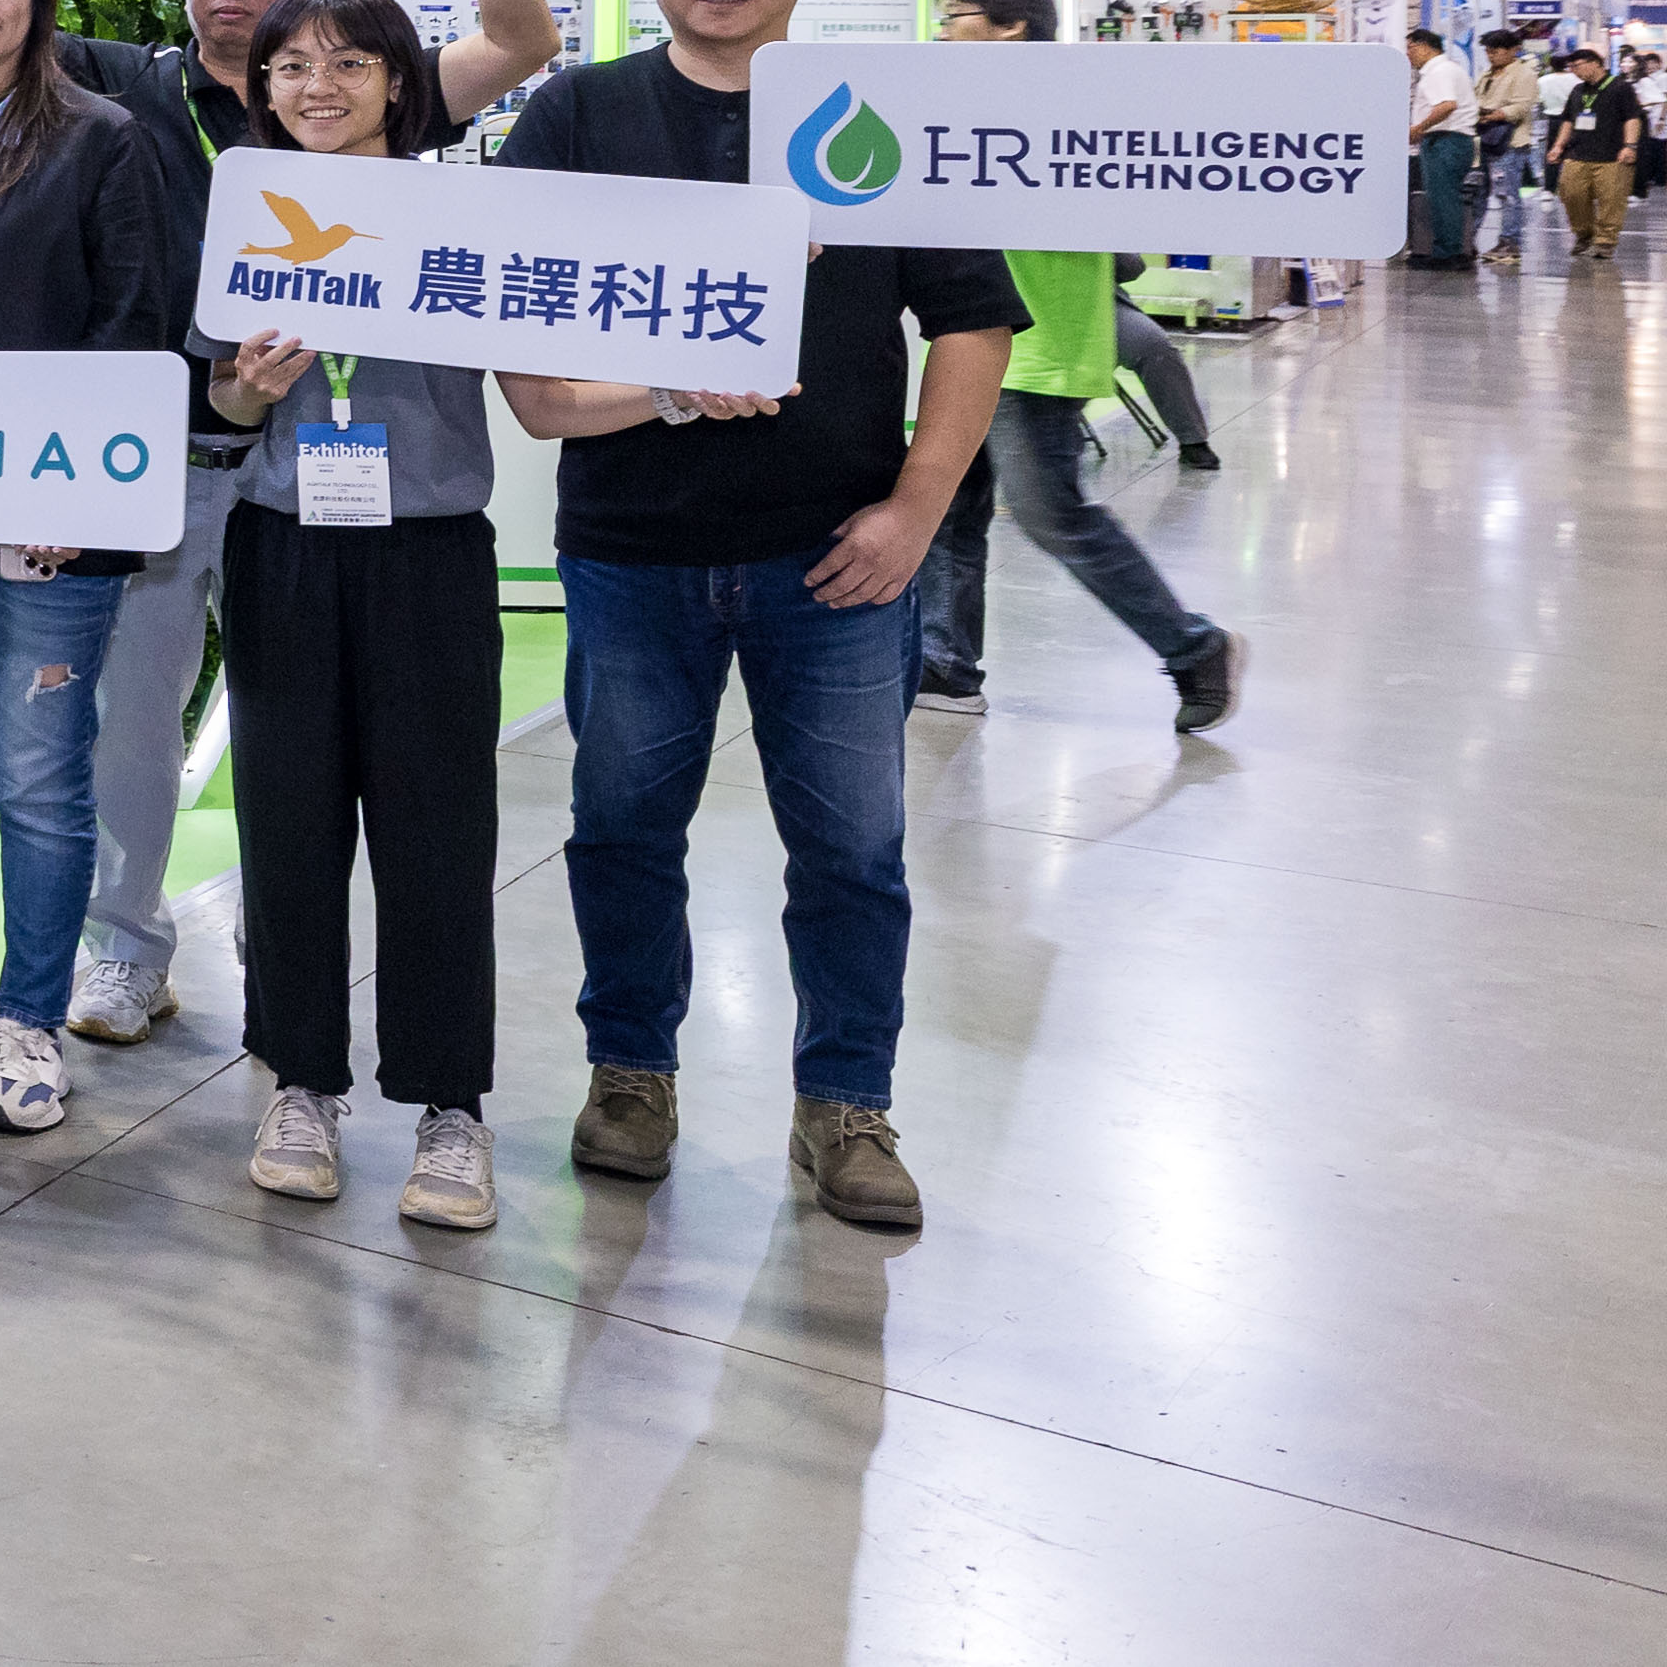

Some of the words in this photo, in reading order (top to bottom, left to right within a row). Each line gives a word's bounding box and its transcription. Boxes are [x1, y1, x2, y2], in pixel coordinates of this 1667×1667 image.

[922, 126, 1041, 187] HR
[1050, 129, 1365, 161] INTELLIGENCE
[1049, 164, 1366, 194] TECHNOLOGY
[227, 260, 383, 309] AgriTalk
[409, 245, 768, 346] 農譯科技
[298, 443, 388, 459] Exhibitor
